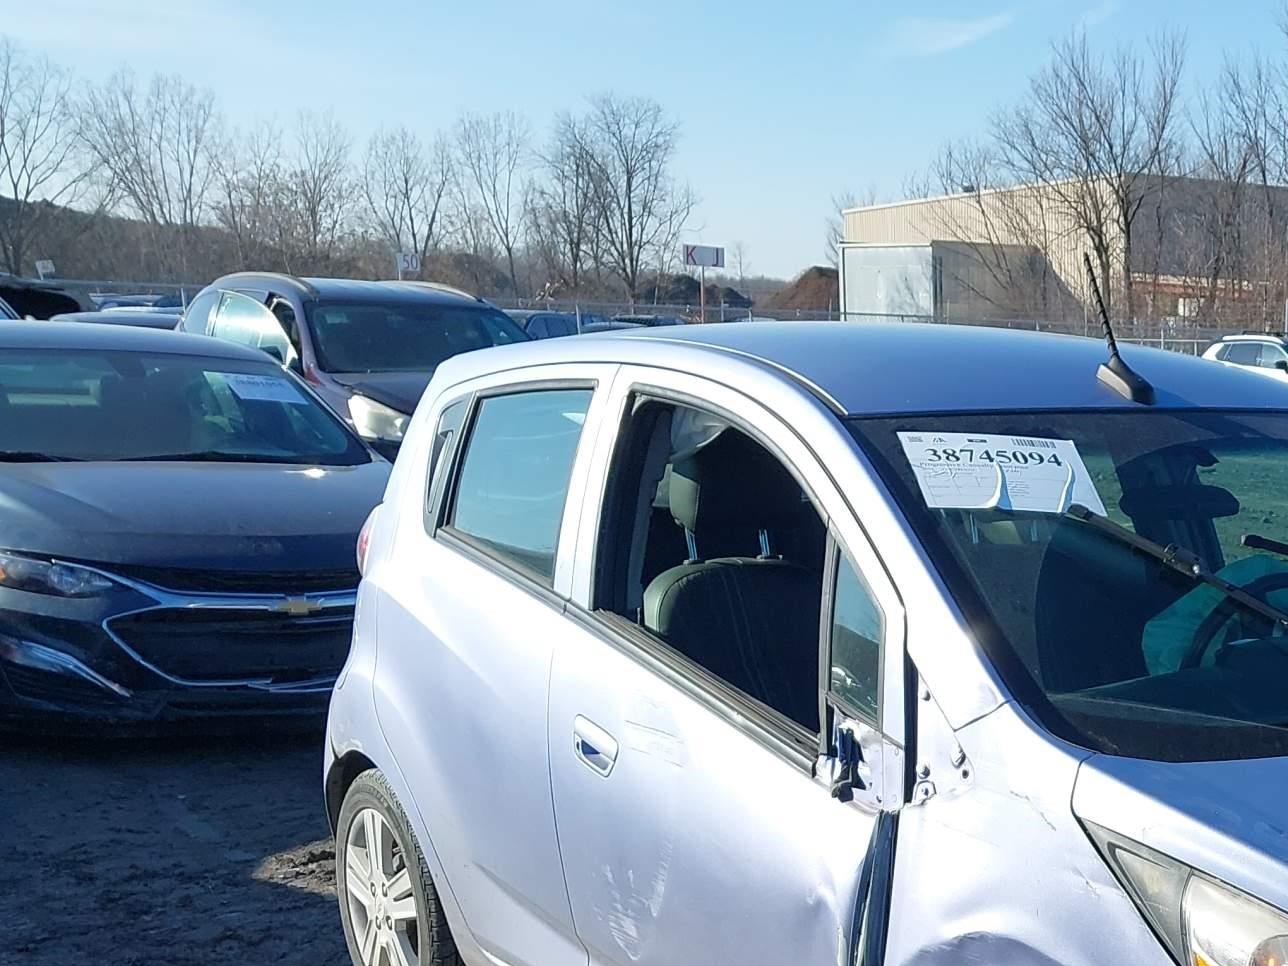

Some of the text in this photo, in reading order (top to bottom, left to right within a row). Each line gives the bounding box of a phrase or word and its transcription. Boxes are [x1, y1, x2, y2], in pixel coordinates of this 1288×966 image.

[402, 254, 418, 270] 50
[686, 245, 719, 267] K J
[924, 448, 1062, 467] 38745094
